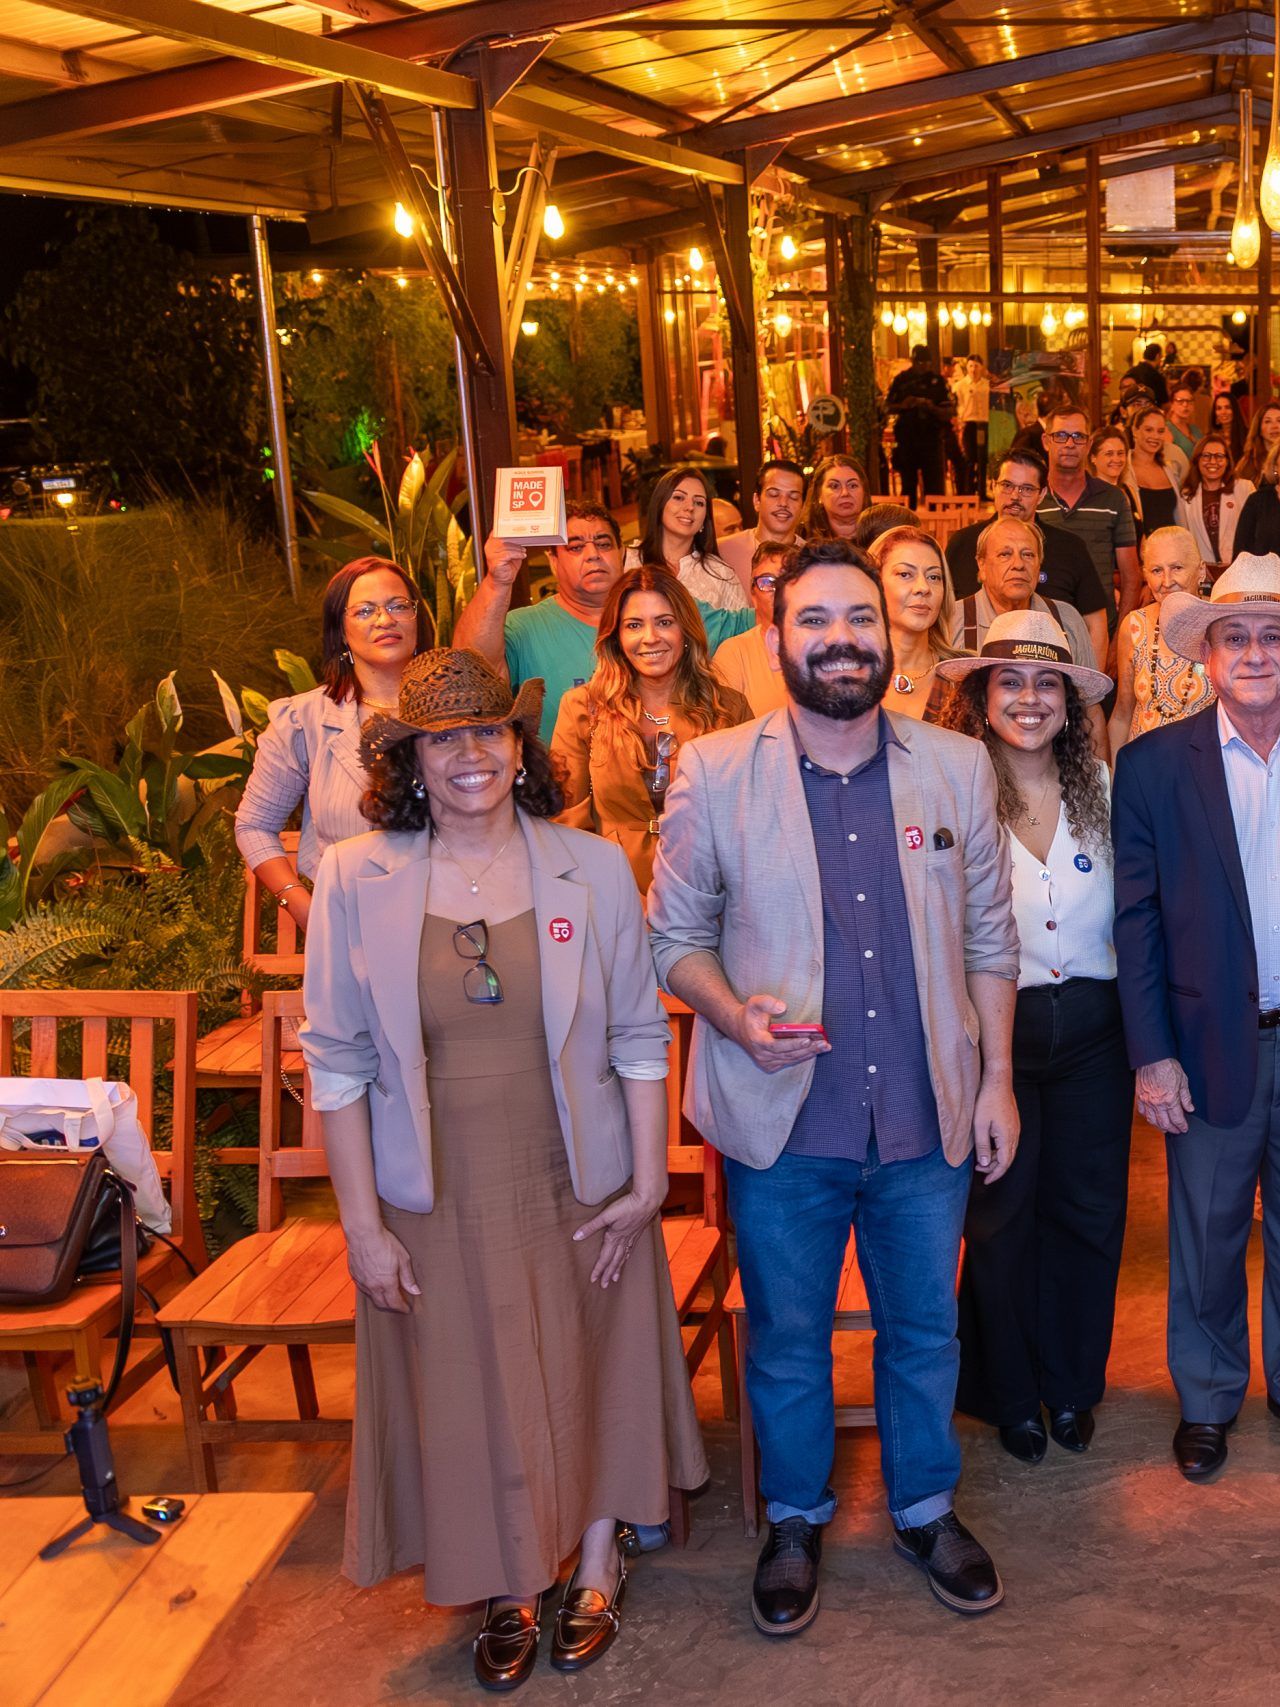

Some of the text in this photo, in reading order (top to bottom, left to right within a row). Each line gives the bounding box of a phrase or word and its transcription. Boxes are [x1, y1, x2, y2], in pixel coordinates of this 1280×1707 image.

[513, 480, 544, 490] MADE
[513, 490, 524, 500] IN
[512, 500, 525, 509] SP
[1012, 644, 1059, 661] JAGUARIÚNA
